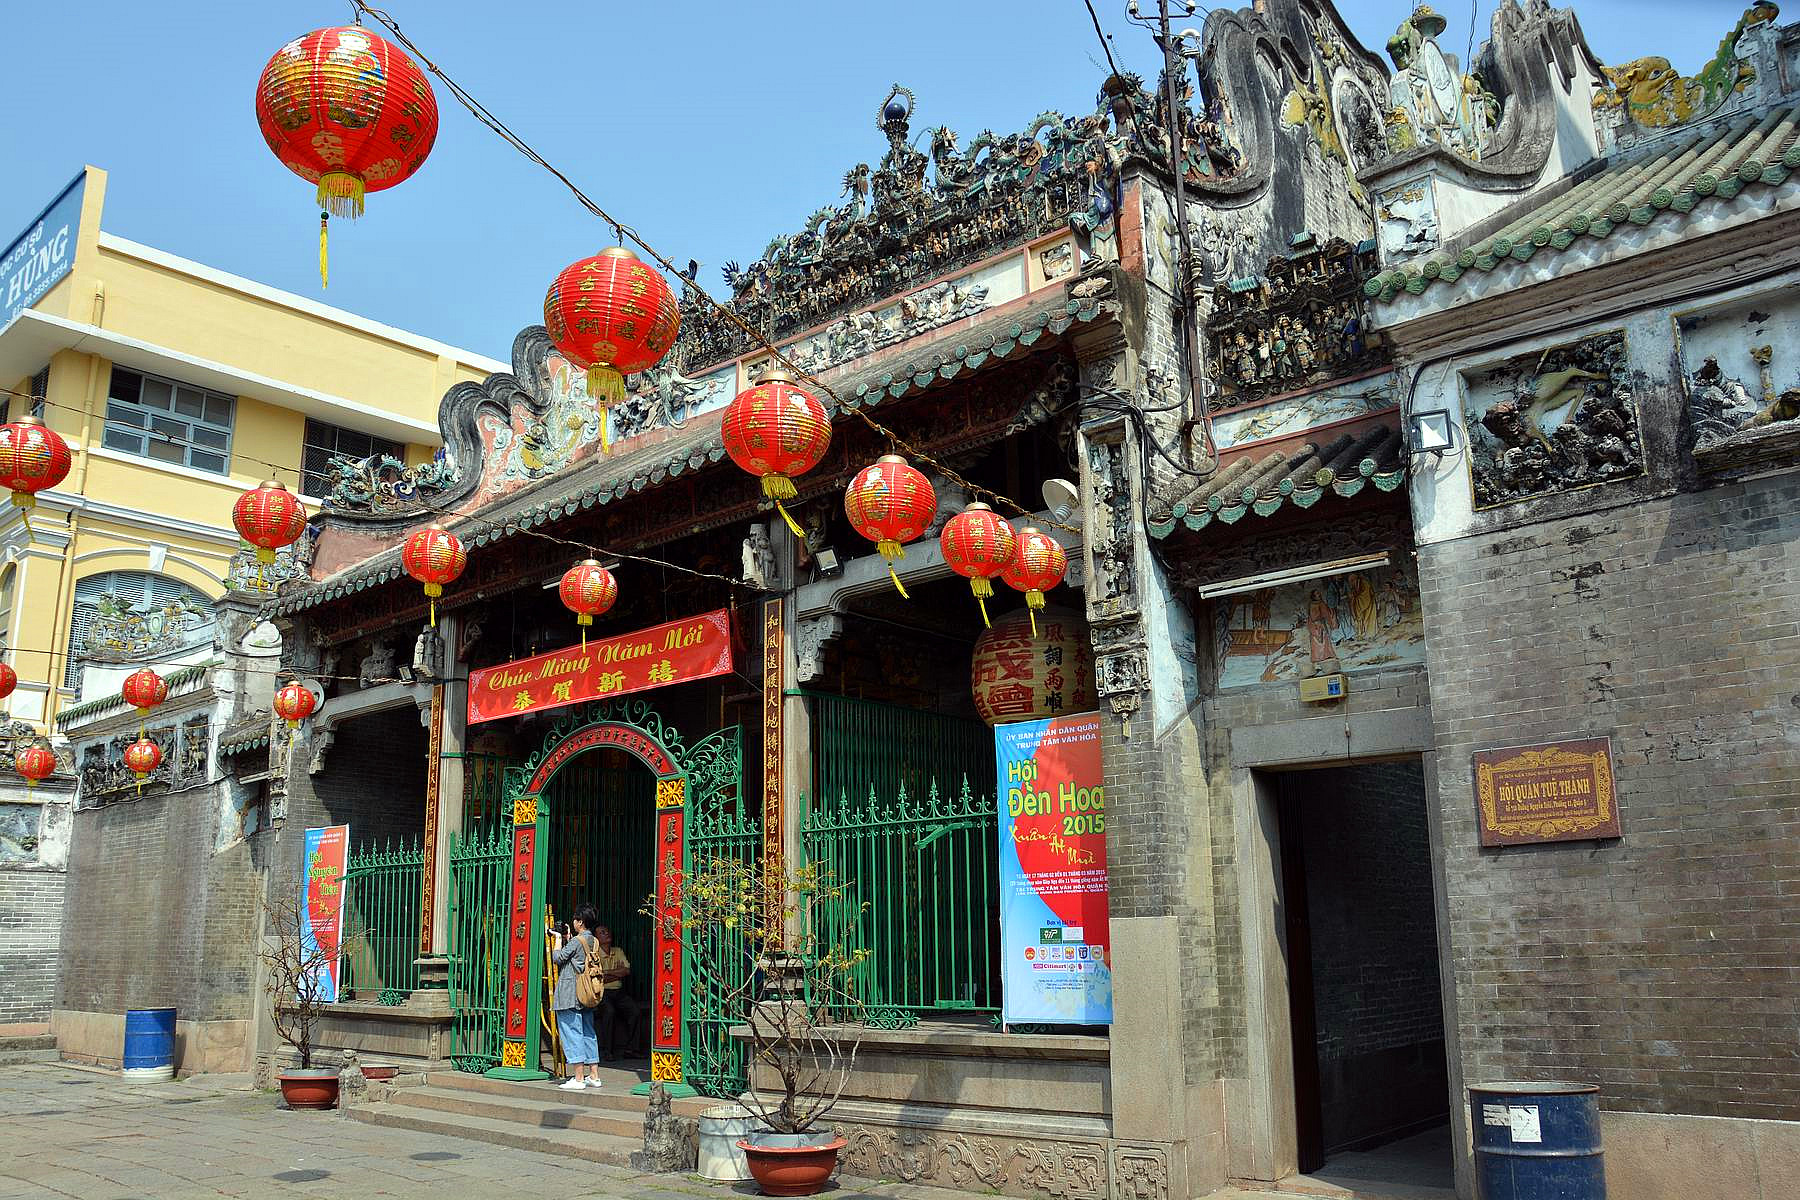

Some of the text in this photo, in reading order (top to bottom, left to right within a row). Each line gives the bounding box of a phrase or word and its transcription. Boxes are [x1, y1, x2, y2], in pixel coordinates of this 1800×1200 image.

[487, 624, 705, 691] Chúc Mừng Năm Mới
[1044, 624, 1065, 713] 風調雨順
[512, 660, 678, 711] 恭賀新禧
[1007, 782, 1104, 818] Đèn Hoa
[1062, 814, 1105, 836] 2015
